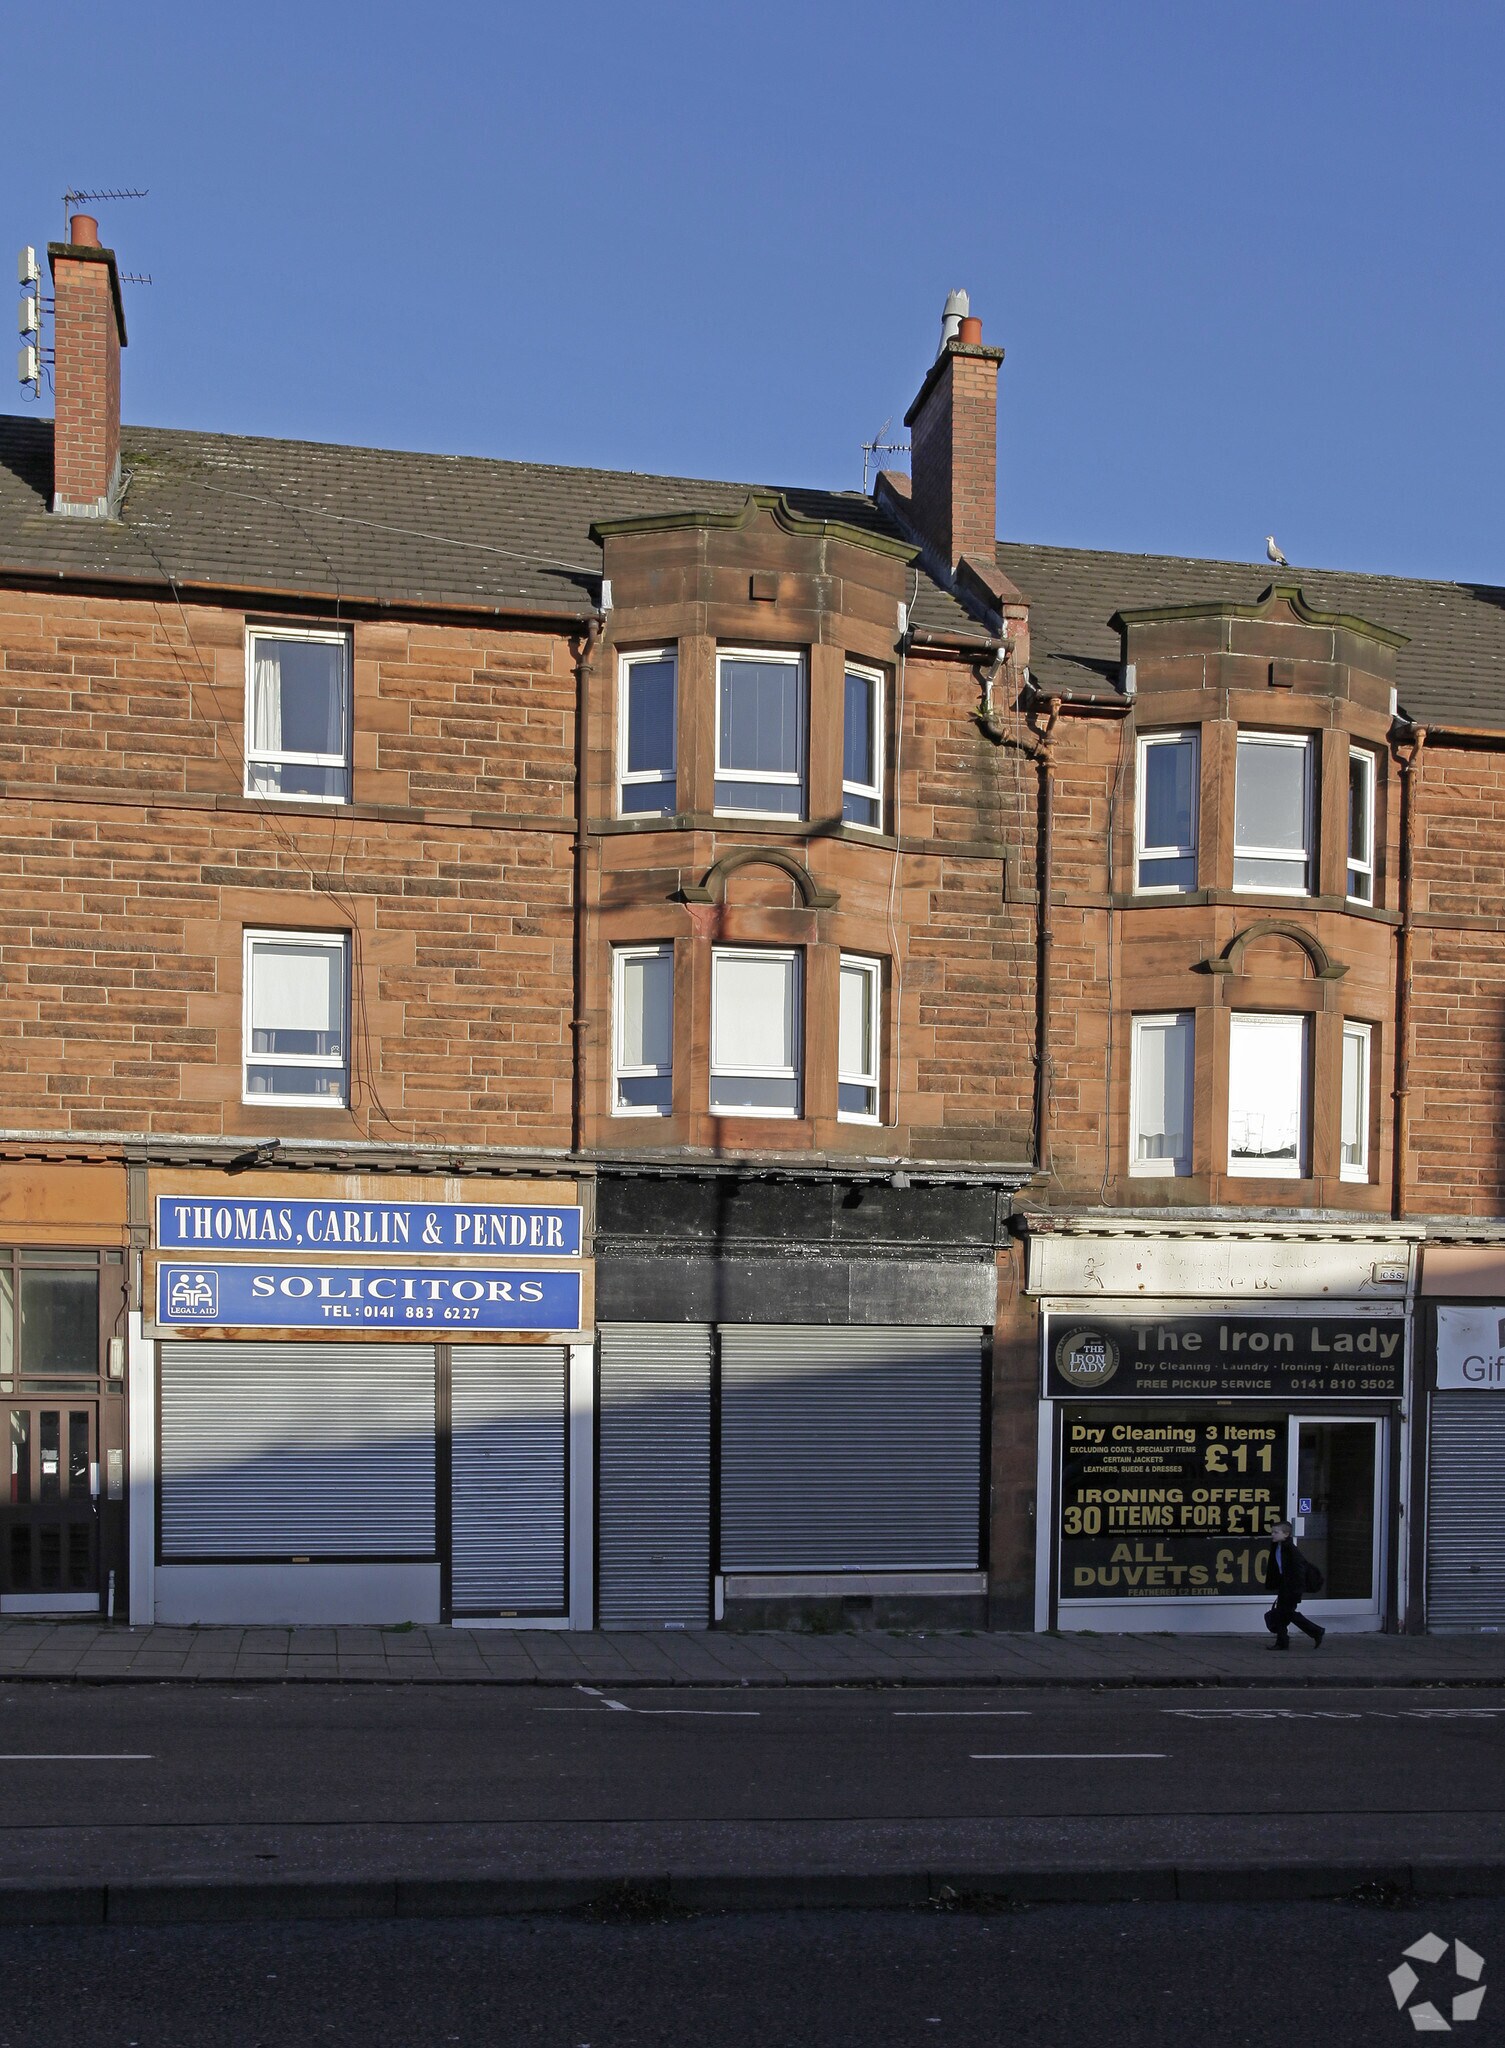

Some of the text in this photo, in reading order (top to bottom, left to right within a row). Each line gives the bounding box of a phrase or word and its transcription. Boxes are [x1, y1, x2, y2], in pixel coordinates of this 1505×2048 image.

[422, 1212, 443, 1245] &
[454, 1213, 565, 1248] PENDER
[252, 1275, 544, 1302] SOLICITORS
[170, 1307, 198, 1315] LEGAL
[405, 1306, 434, 1320] 883
[444, 1307, 480, 1321] 6227
[1130, 1325, 1203, 1351] The
[1219, 1325, 1294, 1352] Iron
[1310, 1326, 1400, 1358] Lady
[1084, 1345, 1105, 1353] THE
[1069, 1352, 1106, 1364] IRON
[1069, 1361, 1107, 1373] LADY
[1135, 1362, 1395, 1373] Dry Cleaning Laundry Ironing Alterations
[1136, 1379, 1395, 1389] FREE PICKUP SERVICE 0141 810 3502
[1071, 1425, 1276, 1443] Dry Cleaning 3 Items
[1069, 1446, 1109, 1454] EXCLUDING
[1135, 1446, 1175, 1454] SPECIALIST
[1176, 1446, 1197, 1454] ITEMS
[1103, 1456, 1164, 1464] CERTAIN JACKETS
[1204, 1444, 1272, 1473] £11
[1121, 1465, 1144, 1473] SUEDE
[1145, 1465, 1150, 1473] &
[1151, 1465, 1183, 1473] DRESSES
[1077, 1488, 1271, 1504] IRONING OFFER
[1064, 1504, 1282, 1535] 30 ITEMS FOR £15
[1110, 1543, 1174, 1563] ALL
[1074, 1565, 1209, 1587] DUVETS
[1128, 1588, 1176, 1597] FEATHERED
[1191, 1587, 1219, 1596] EXTRA
